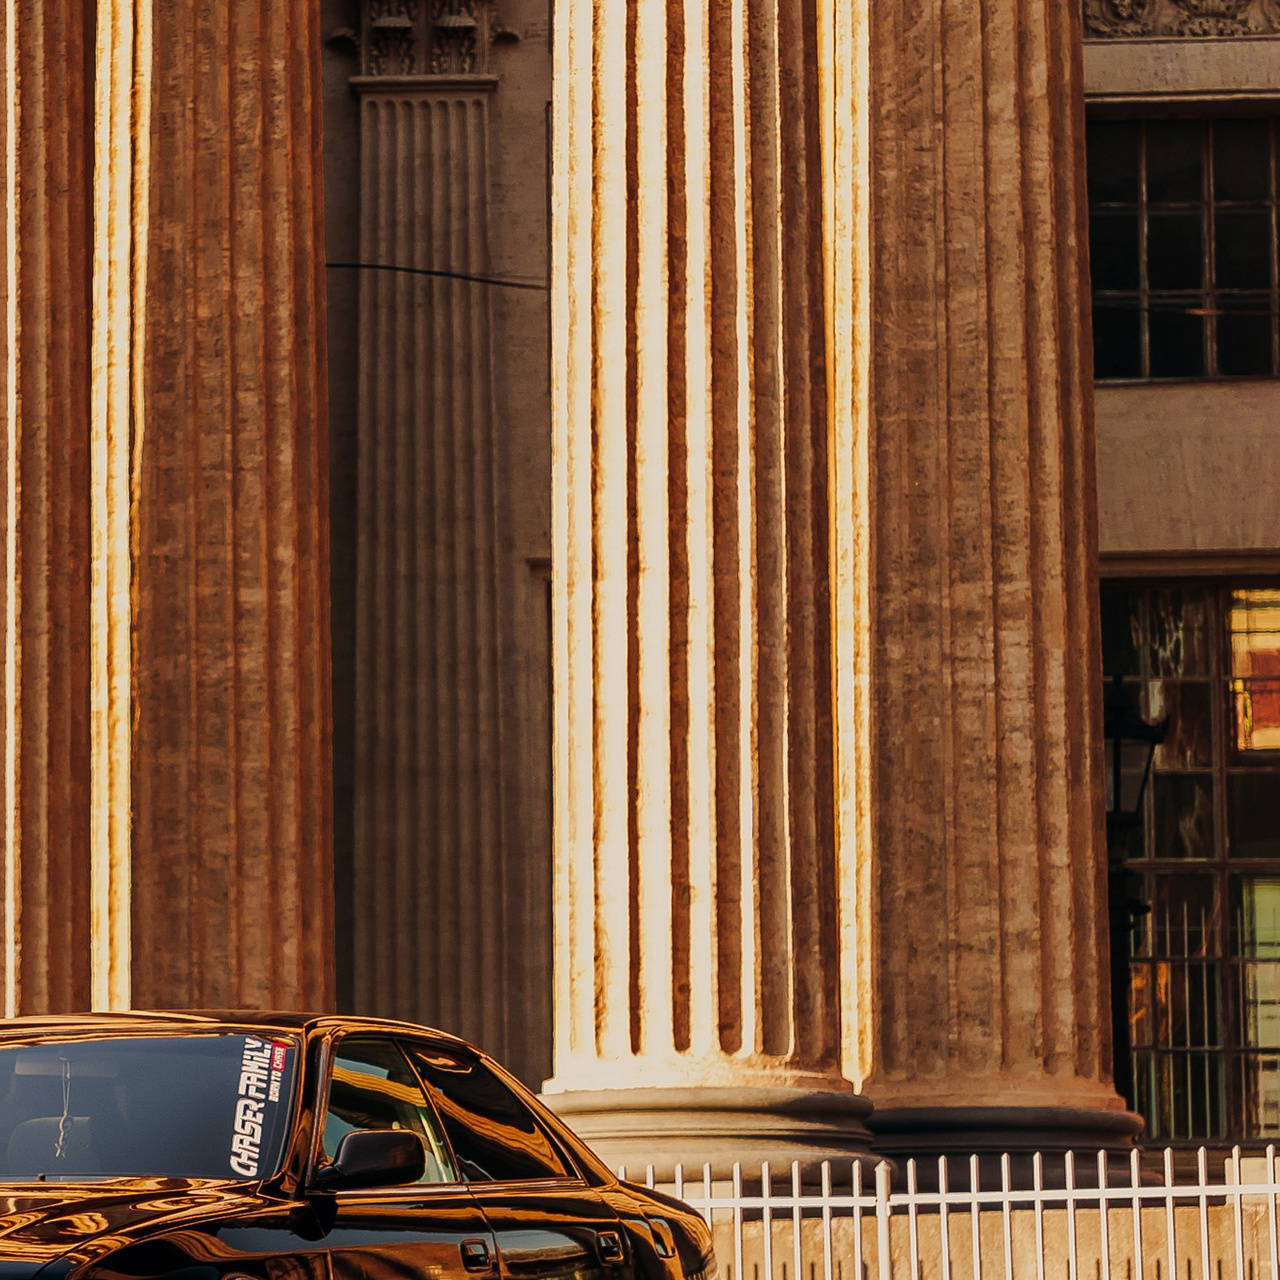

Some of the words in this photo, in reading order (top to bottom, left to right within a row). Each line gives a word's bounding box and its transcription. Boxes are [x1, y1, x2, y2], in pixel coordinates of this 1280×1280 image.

[273, 1046, 285, 1069] CHASE
[271, 1070, 282, 1081] TO
[268, 1081, 281, 1102] BORN
[230, 1098, 265, 1177] CHASER
